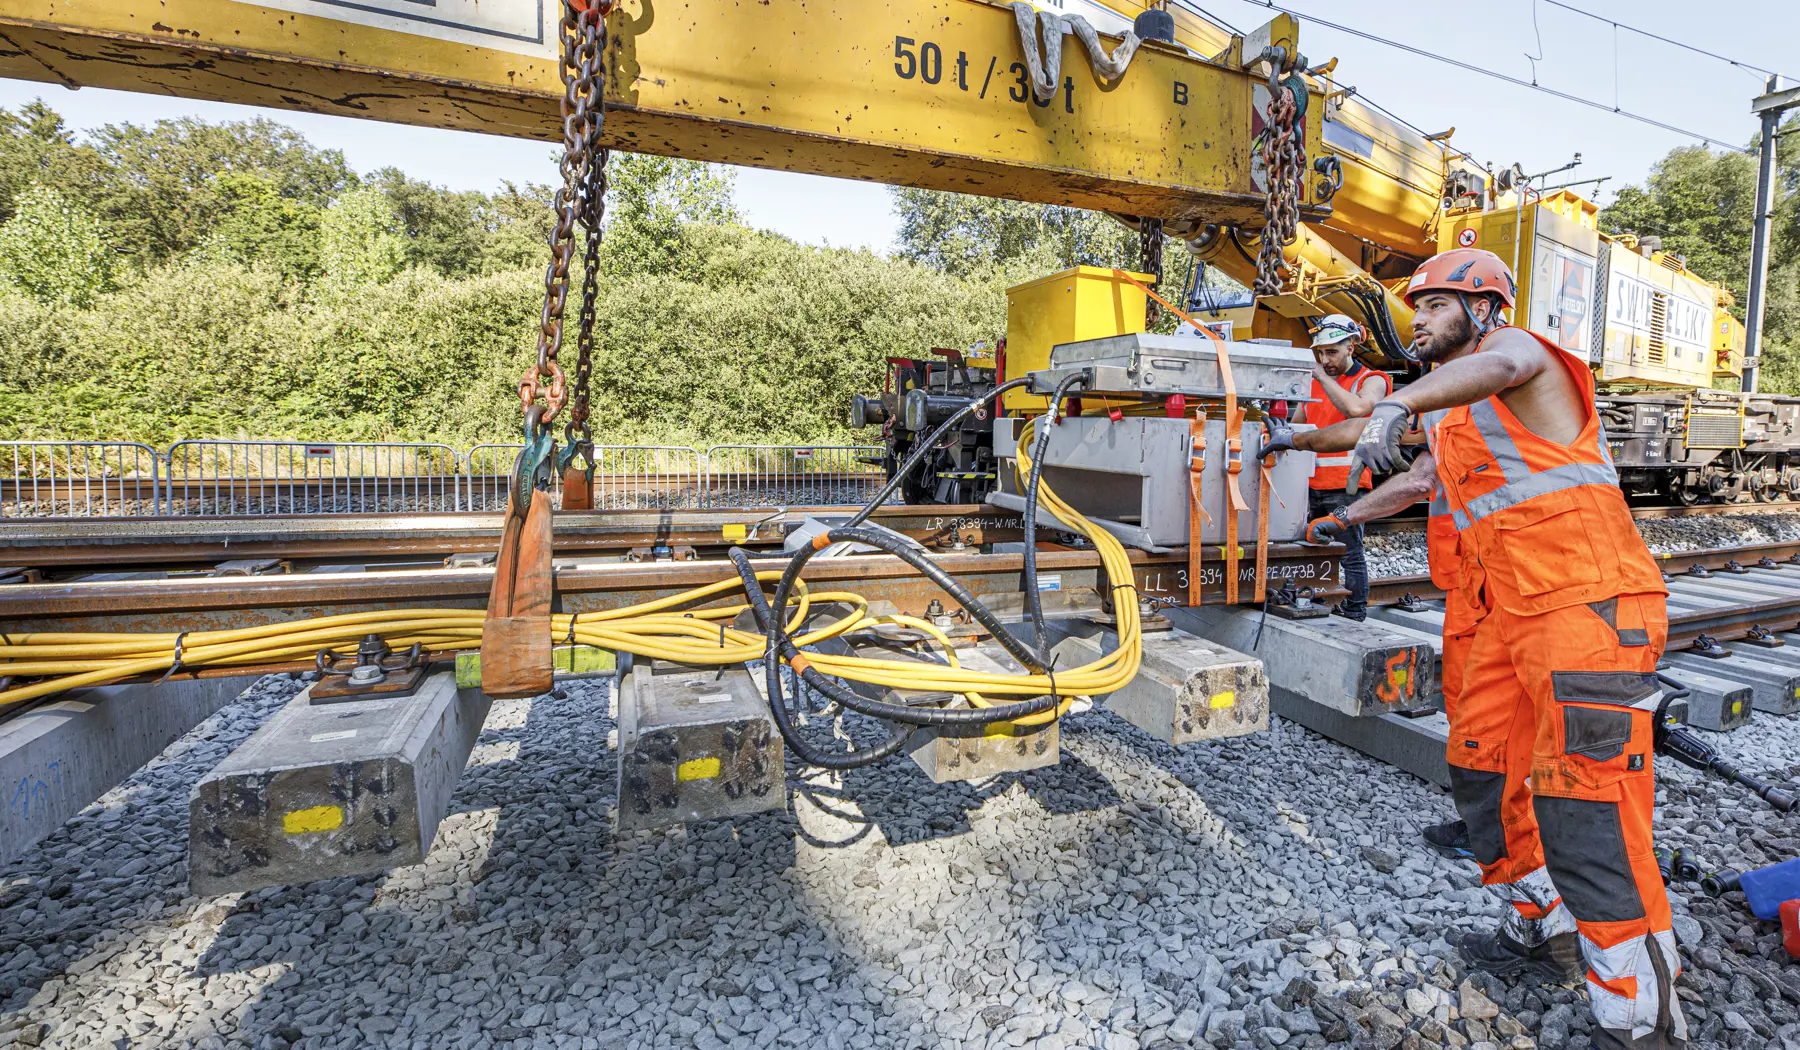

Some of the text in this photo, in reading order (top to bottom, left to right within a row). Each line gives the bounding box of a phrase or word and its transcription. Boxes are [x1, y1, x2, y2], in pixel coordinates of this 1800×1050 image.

[894, 35, 942, 85] 50
[956, 50, 969, 91] t
[1009, 62, 1052, 108] 3
[1064, 76, 1075, 114] t
[1173, 81, 1189, 106] B
[1616, 279, 1707, 342] SWIEELSKY
[1743, 358, 1757, 367] 35
[925, 516, 944, 531] LR
[1144, 573, 1168, 592] LL
[1177, 568, 1223, 589] 3394
[1319, 560, 1332, 581] 2
